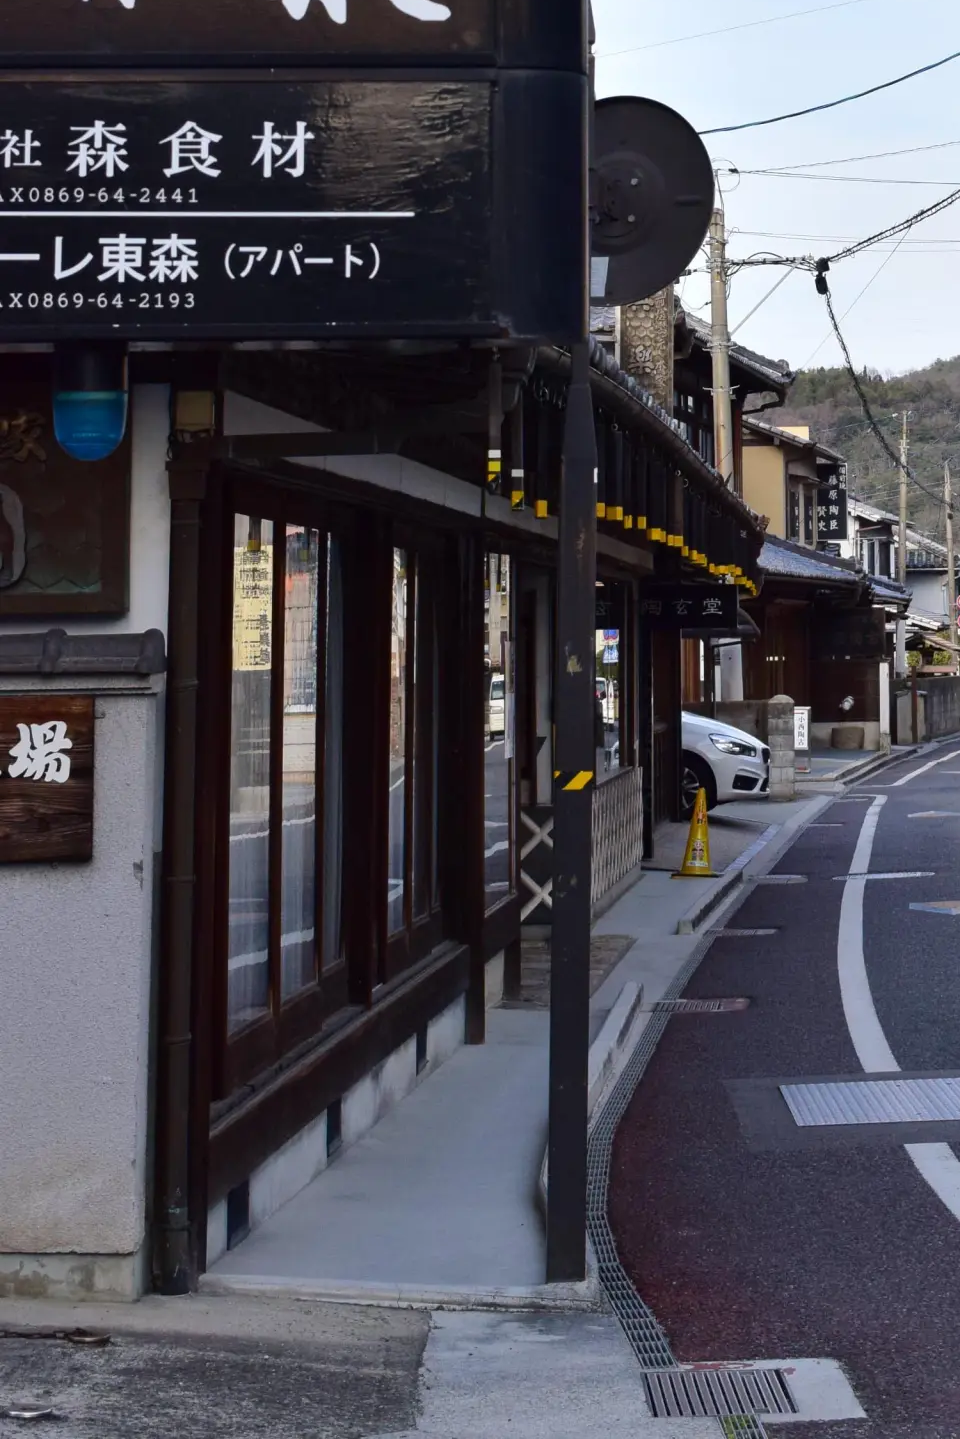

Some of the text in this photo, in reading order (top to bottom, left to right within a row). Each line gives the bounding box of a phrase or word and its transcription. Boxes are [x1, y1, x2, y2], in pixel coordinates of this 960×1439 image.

[66, 120, 314, 178] 森食材
[0, 186, 199, 204] X0869-64-2441
[0, 291, 196, 309] X0869-64-2193
